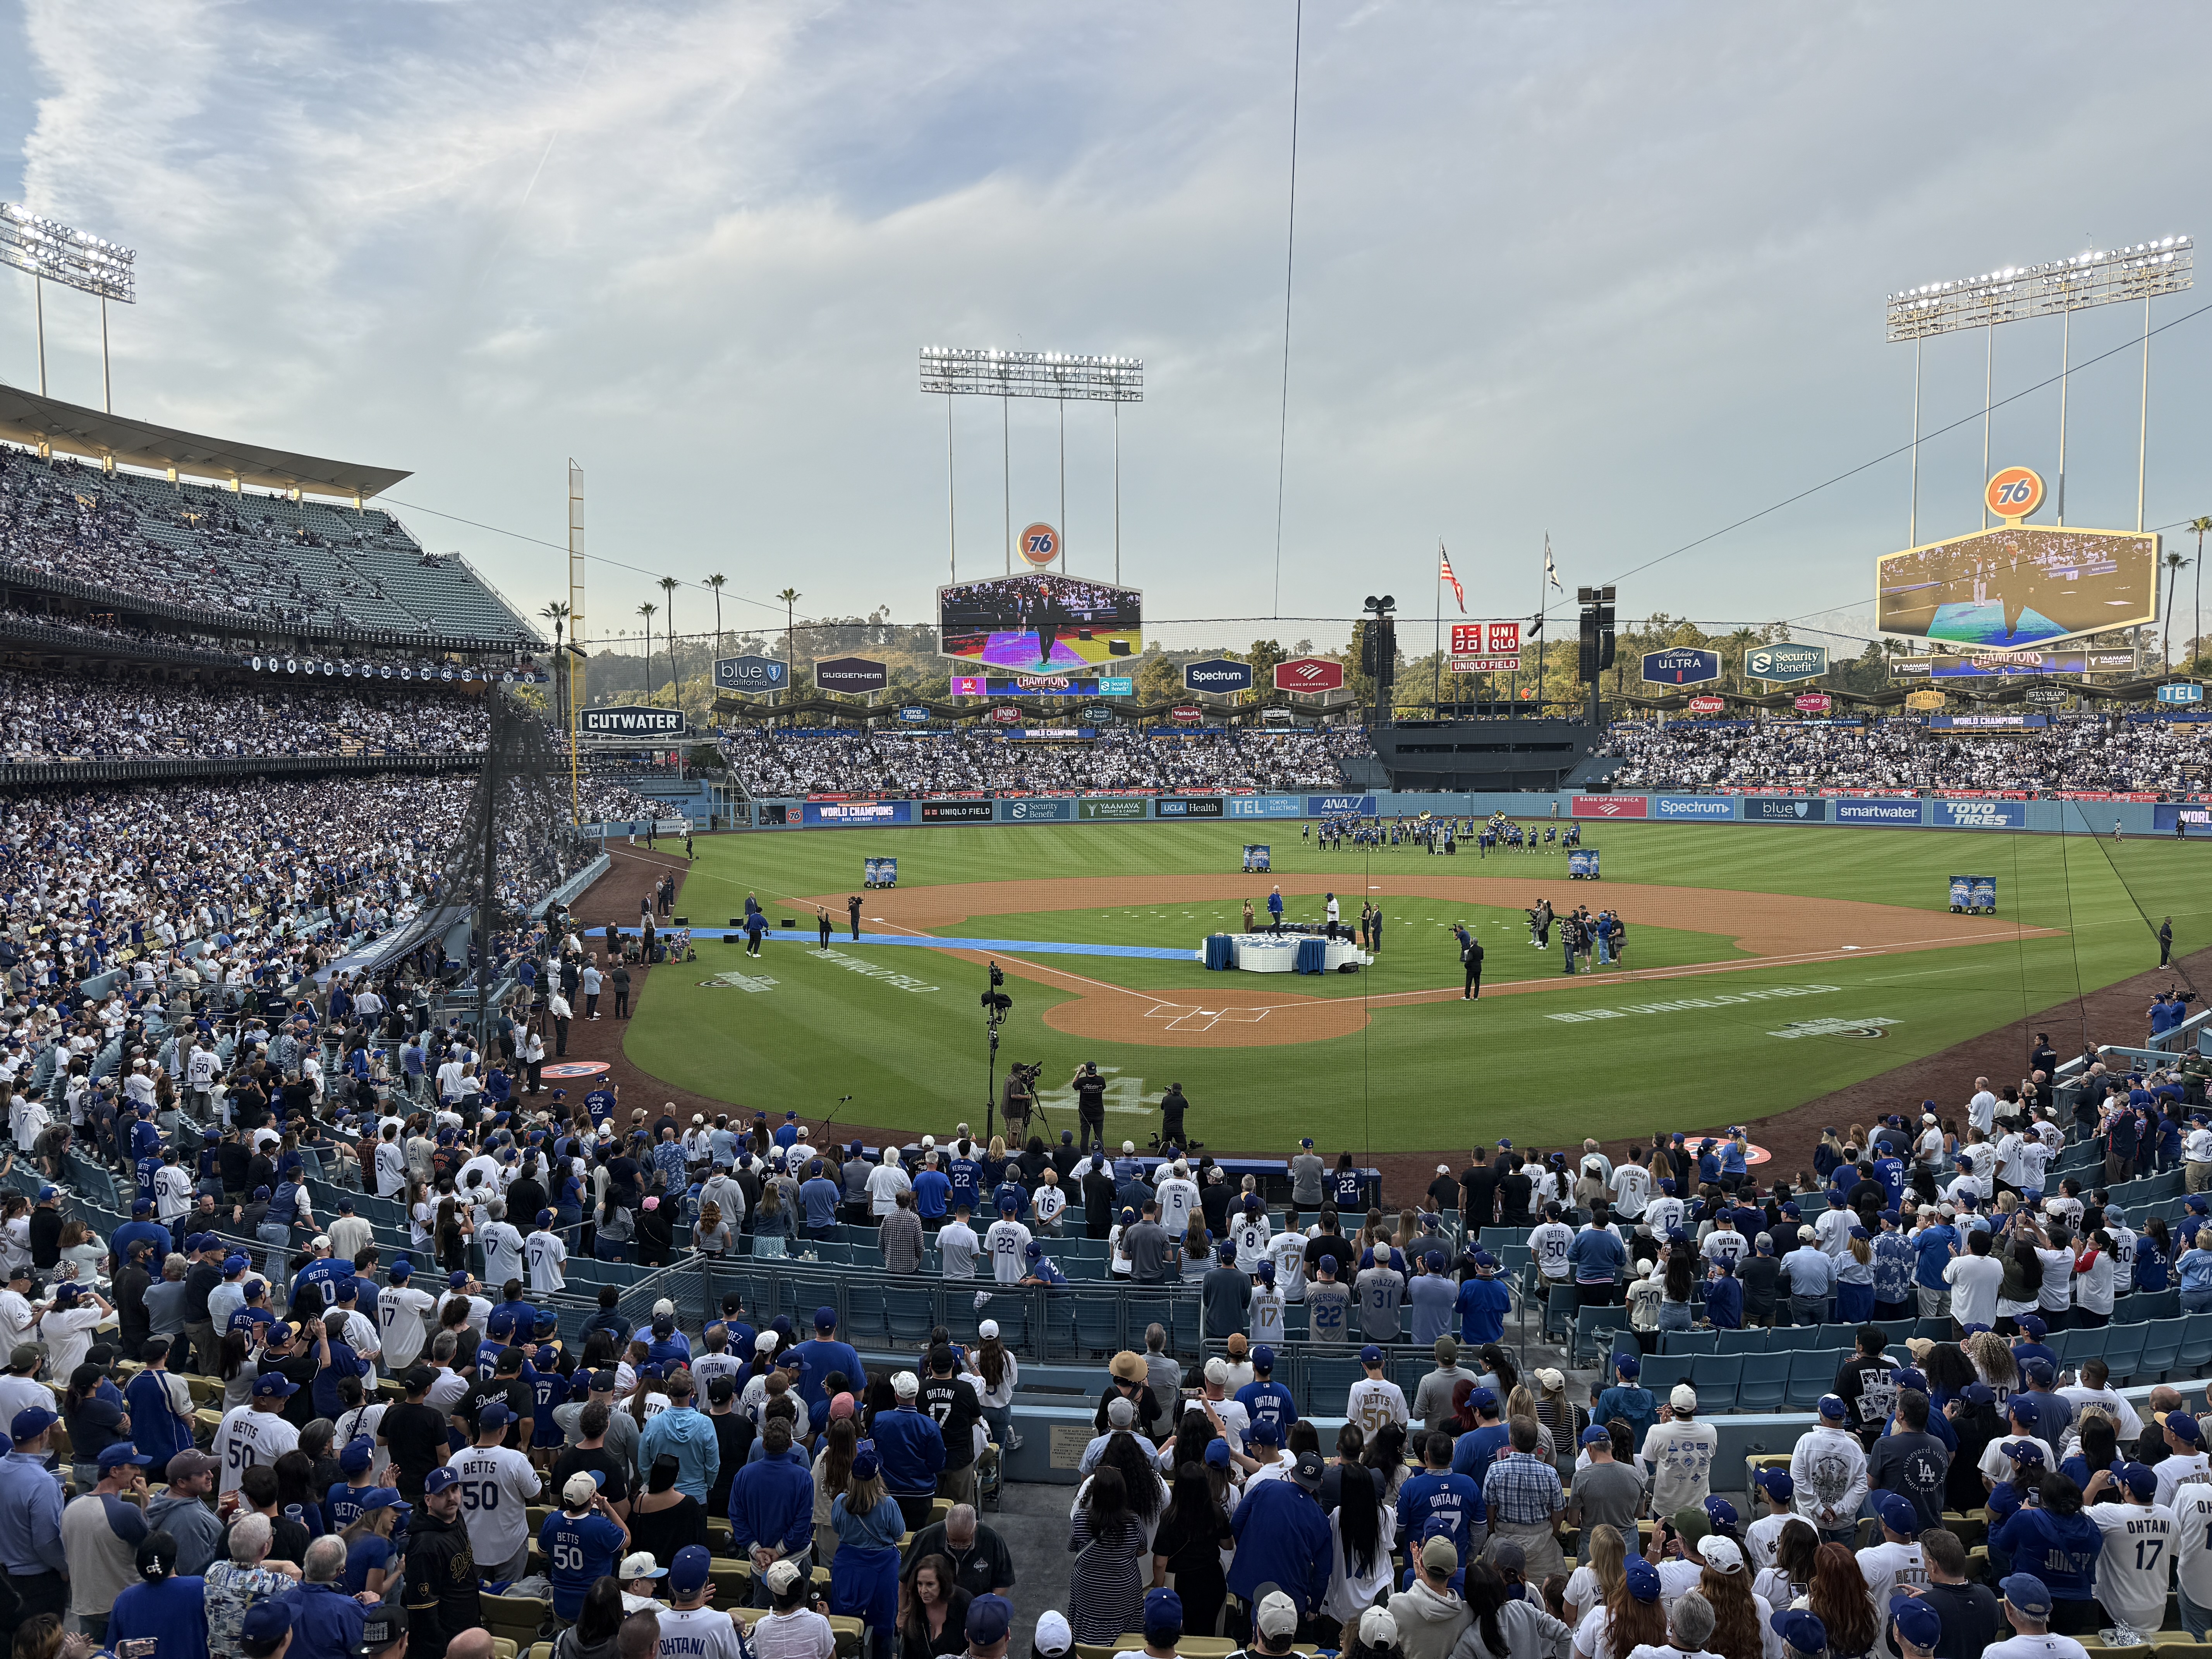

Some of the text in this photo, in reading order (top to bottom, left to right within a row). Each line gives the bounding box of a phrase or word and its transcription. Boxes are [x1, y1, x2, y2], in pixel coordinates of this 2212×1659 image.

[1996, 477, 2032, 505] 76
[1028, 533, 1053, 554] 76
[1456, 628, 1477, 639] ユニ
[1492, 627, 1513, 637] UNI
[1455, 640, 1477, 650] クロ
[1492, 639, 1515, 651] QLO
[1776, 652, 1819, 662] Security
[272, 661, 276, 669] 2
[1455, 661, 1515, 670] UNIQLO FIELD
[1659, 659, 1701, 669] ULTRA
[1776, 663, 1812, 673] Benefit
[722, 662, 762, 678] blue
[1193, 671, 1242, 683] Spectrum
[962, 680, 976, 690] Jack
[1910, 692, 1941, 706] JIM BEAM
[2163, 687, 2197, 700] TEL
[1691, 700, 1721, 710] Churu
[997, 709, 1017, 718] JINRO
[588, 714, 676, 729] CUTWATER
[1029, 802, 1058, 811] Security
[1189, 803, 1217, 812] Health
[1233, 801, 1263, 814] TEL
[1322, 799, 1348, 808] ANA
[1661, 800, 1725, 814] Spectrum
[1763, 802, 1793, 813] blue
[1946, 803, 1996, 814] TOYO
[789, 811, 801, 820] 76
[820, 806, 893, 817] WORLD CHAMPIONS
[940, 807, 966, 816] UNIQLO
[1841, 806, 1916, 817] smartwater
[1954, 814, 2007, 826] TIRES
[830, 958, 940, 992] UNIQLO FIELD
[1630, 985, 1842, 1013] UNIQLO FIELD
[196, 1063, 208, 1074] 50
[687, 1139, 695, 1152] 14
[138, 1163, 150, 1171] BETTS
[378, 1158, 383, 1171] 5
[1886, 1162, 1904, 1171] PIAZZA
[1622, 1171, 1646, 1180] FREEMAN
[1891, 1171, 1903, 1186] 31
[1042, 1197, 1055, 1211] 16
[1664, 1205, 1680, 1214] OHTANI
[2068, 1215, 2080, 1228] 16
[483, 1229, 500, 1238] OHTANI
[995, 1227, 1018, 1237] KERSHAW
[1547, 1230, 1565, 1238] BETTS
[529, 1238, 545, 1247] OHTANI
[1246, 1231, 1255, 1248] 8
[1718, 1238, 1740, 1247] OHTANI
[1281, 1243, 1302, 1252] OHTANI
[531, 1249, 543, 1267] 17
[309, 1269, 329, 1280] BETTS
[1372, 1279, 1396, 1288] PIAZZA
[1257, 1296, 1280, 1305] OHTANI
[1373, 1290, 1391, 1309] 31
[235, 1314, 254, 1326] BETTS
[701, 1363, 727, 1374] OHTANI
[535, 1381, 553, 1389] OHTANI
[476, 1389, 508, 1410] Dodgers
[537, 1388, 551, 1405] 17
[927, 1389, 955, 1400] OHTANI
[1363, 1393, 1391, 1407] BETTS
[1254, 1395, 1281, 1408] OHTANI
[233, 1420, 258, 1439] BETTS
[464, 1461, 496, 1474] BETTS
[1918, 1459, 1935, 1482] LA
[441, 1469, 450, 1479] LA
[463, 1481, 498, 1510] 50
[1429, 1493, 1462, 1508] OHTANI
[334, 1502, 363, 1517] BETTS
[2127, 1520, 2170, 1534] OHTANI
[557, 1532, 579, 1545] BETTS
[554, 1545, 583, 1570] 50
[2136, 1539, 2164, 1570] 17
[659, 1638, 706, 1656] OHTANI
